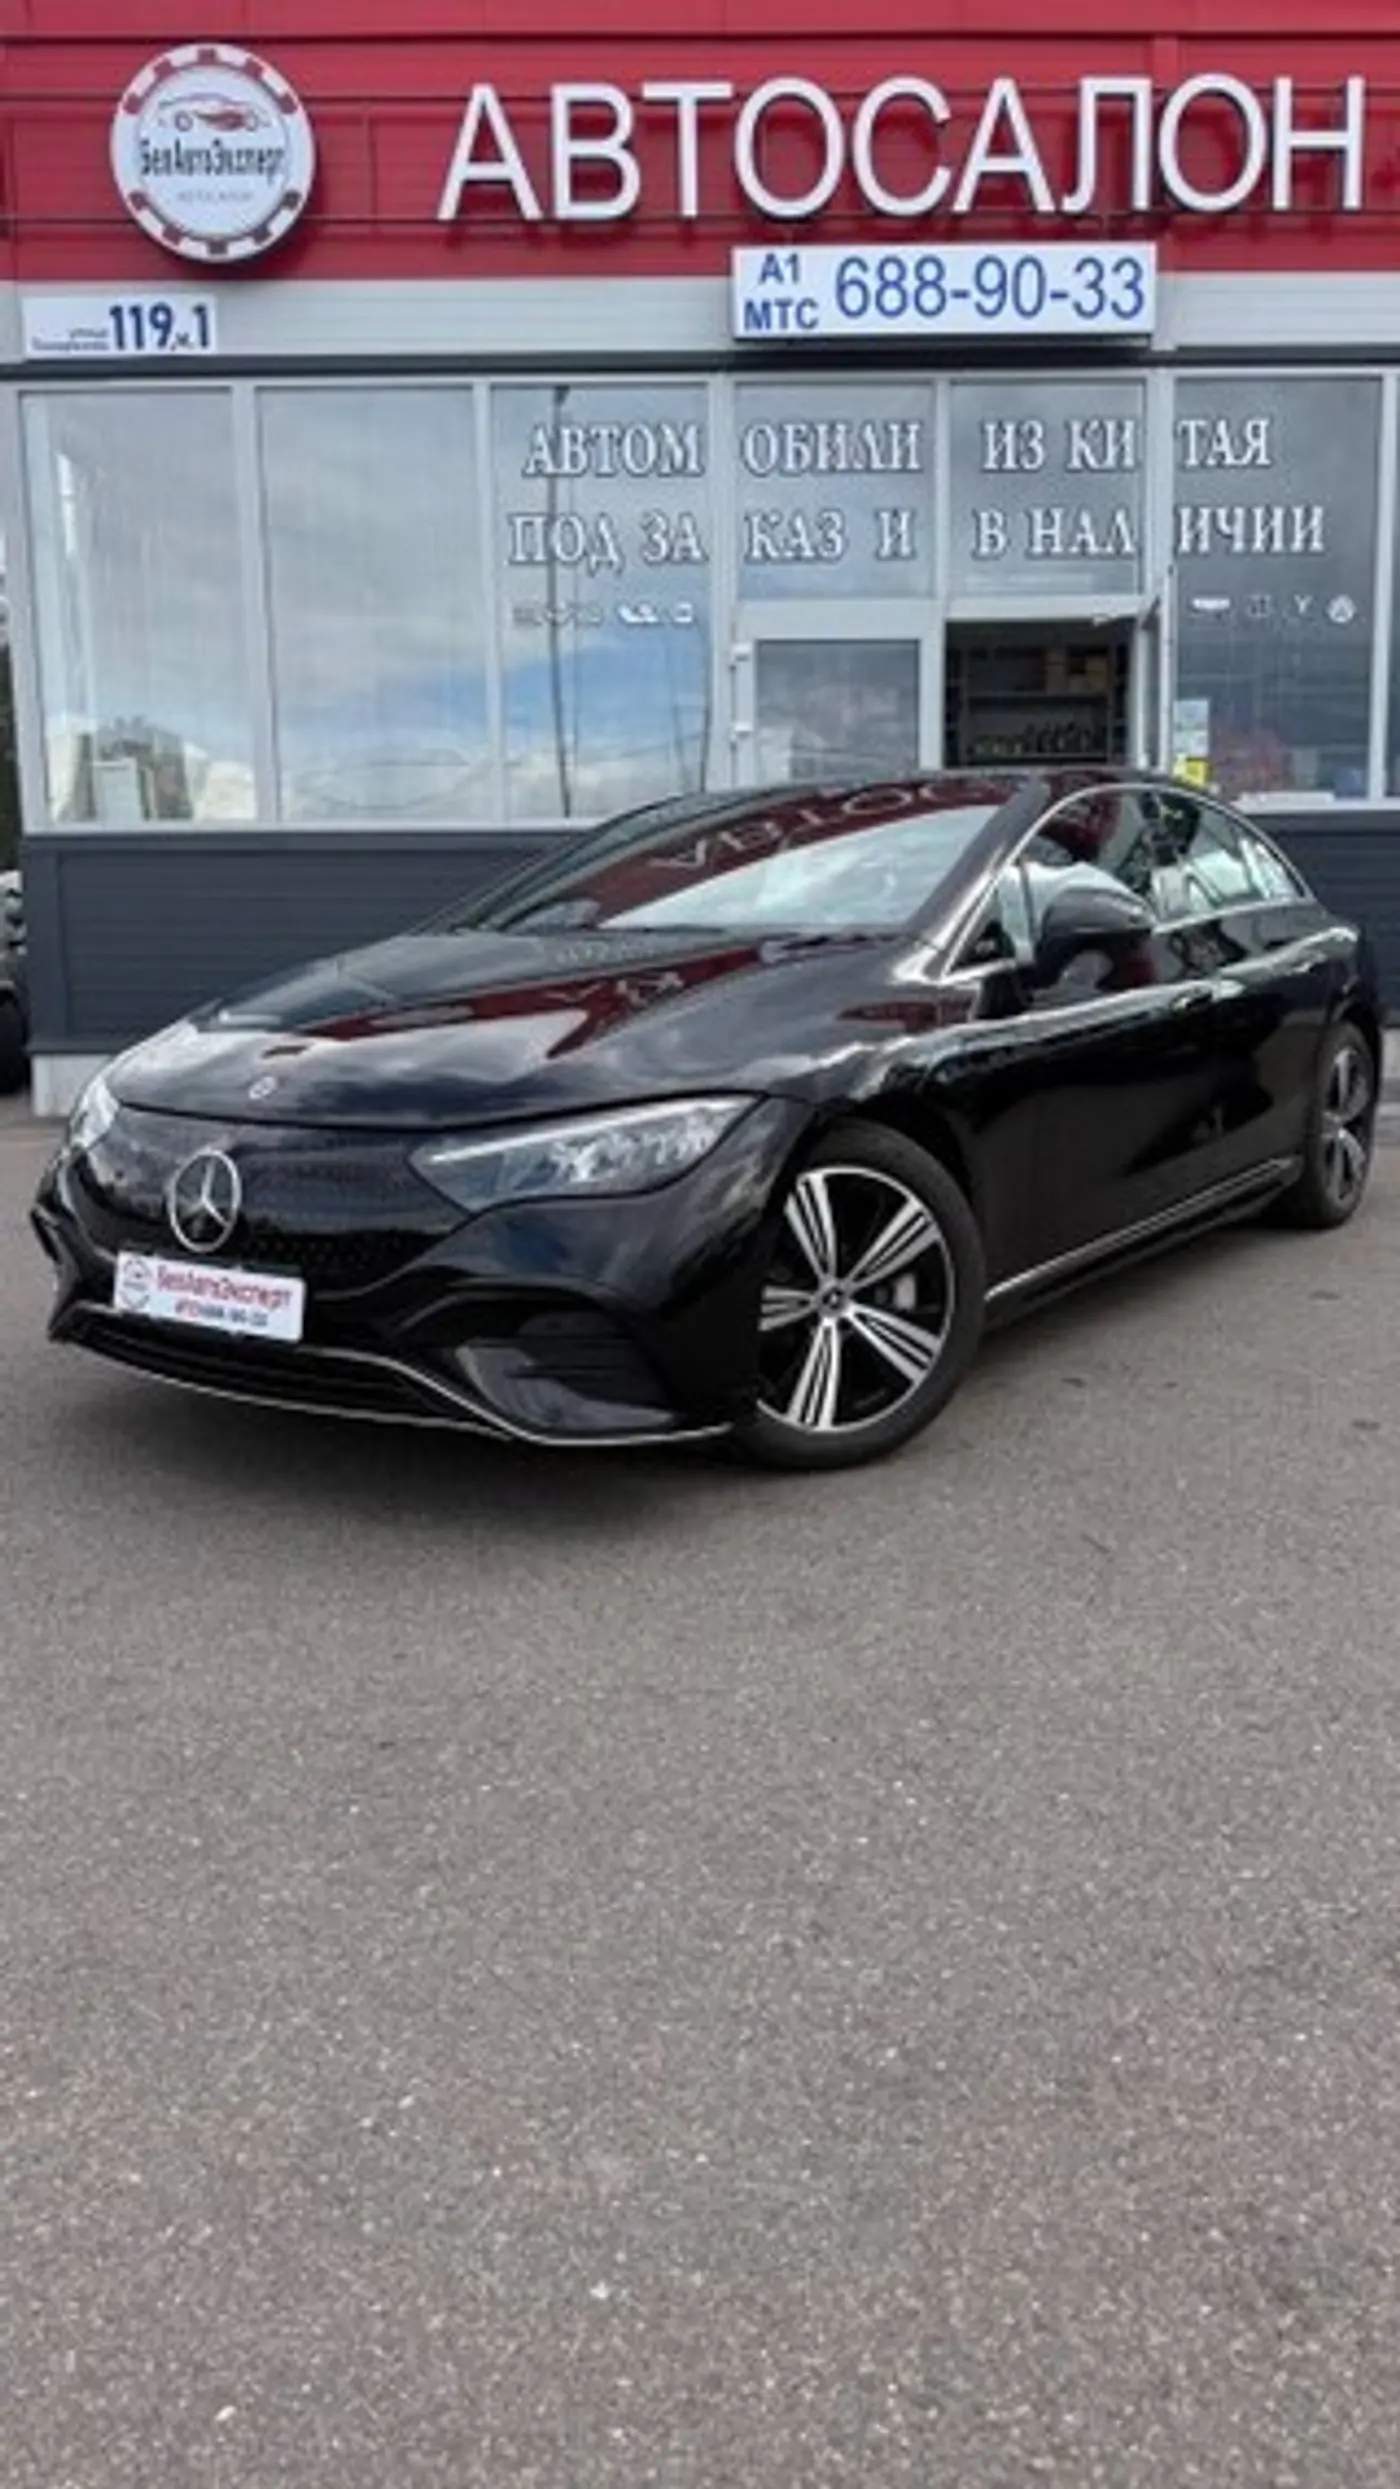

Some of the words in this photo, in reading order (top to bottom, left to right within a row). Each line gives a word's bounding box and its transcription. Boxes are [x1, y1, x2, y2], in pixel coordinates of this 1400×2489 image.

[437, 74, 1365, 223] АВТОСАЛОН
[834, 254, 1145, 319] 688-90-33
[981, 418, 1046, 472] ИЗ
[509, 513, 622, 576] ПОД
[974, 508, 1009, 558] В
